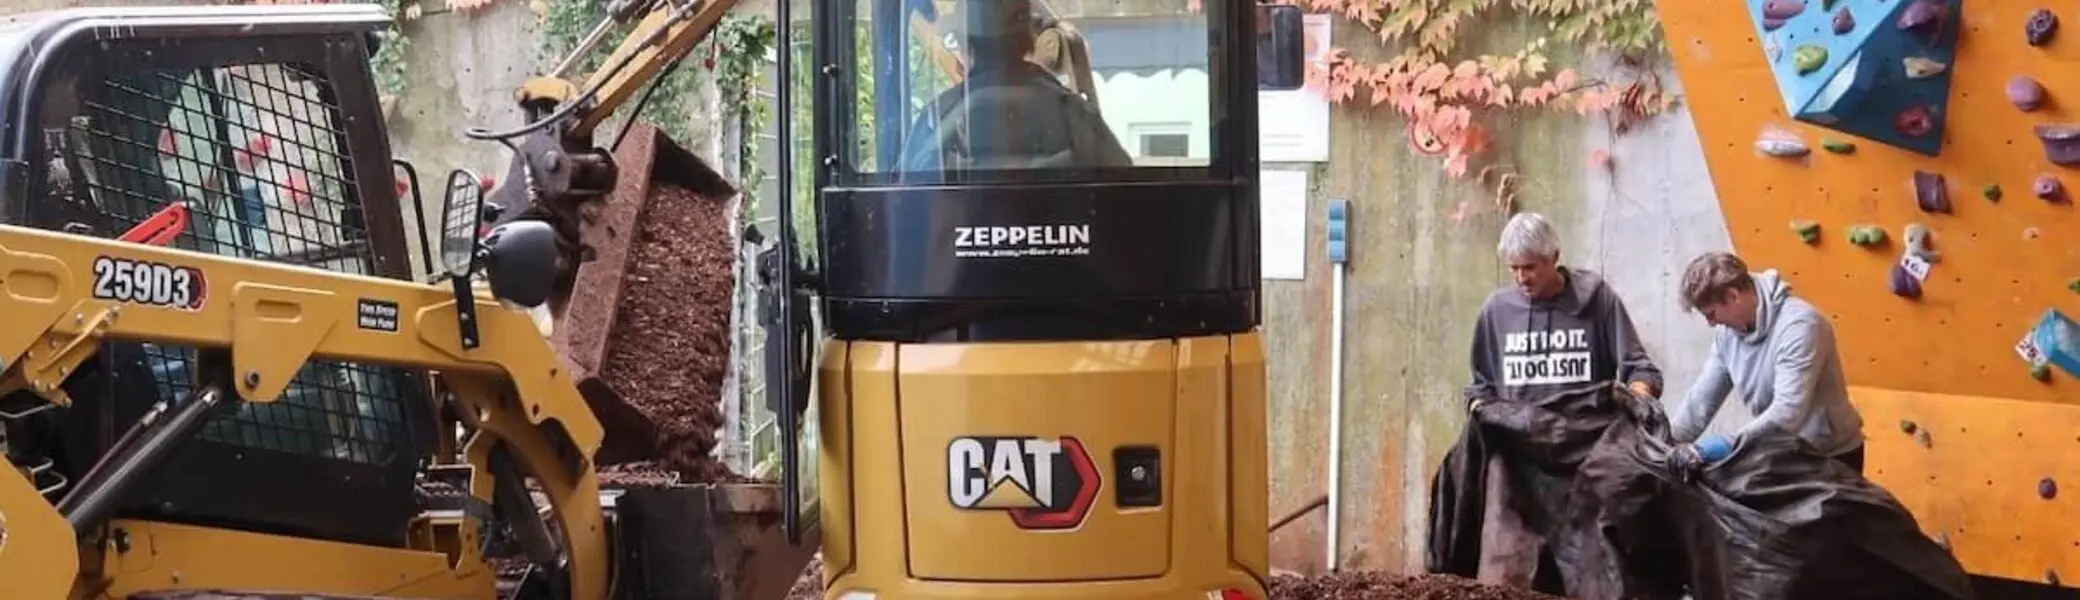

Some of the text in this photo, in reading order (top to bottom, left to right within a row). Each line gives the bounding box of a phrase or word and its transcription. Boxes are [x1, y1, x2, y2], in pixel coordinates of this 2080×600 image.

[955, 225, 1090, 247] ZEPPELIN
[93, 256, 191, 307] 259D3
[1504, 331, 1539, 353] JUST
[1524, 359, 1549, 379] DO
[1553, 357, 1587, 377] JUST
[949, 437, 1062, 508] CAT
